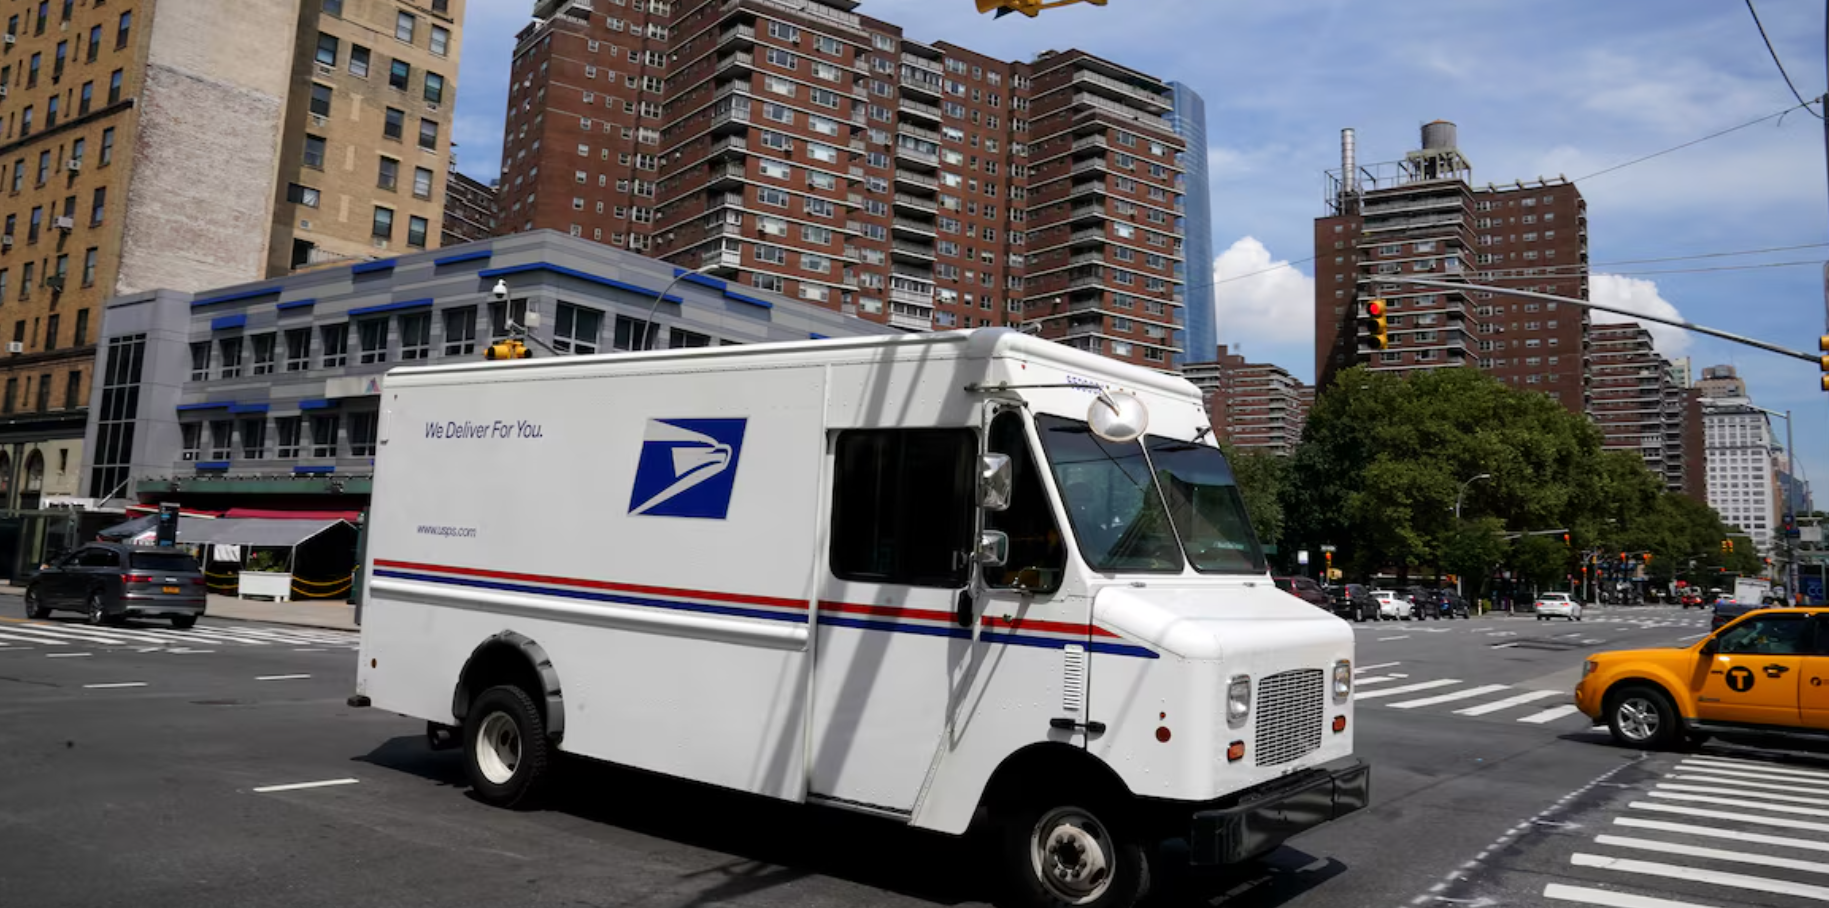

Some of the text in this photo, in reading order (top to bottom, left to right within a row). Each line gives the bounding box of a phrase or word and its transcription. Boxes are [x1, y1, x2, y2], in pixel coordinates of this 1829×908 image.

[425, 420, 543, 439] We Deliver For You.
[417, 525, 477, 538] www.usps.com
[1732, 670, 1748, 690] T
